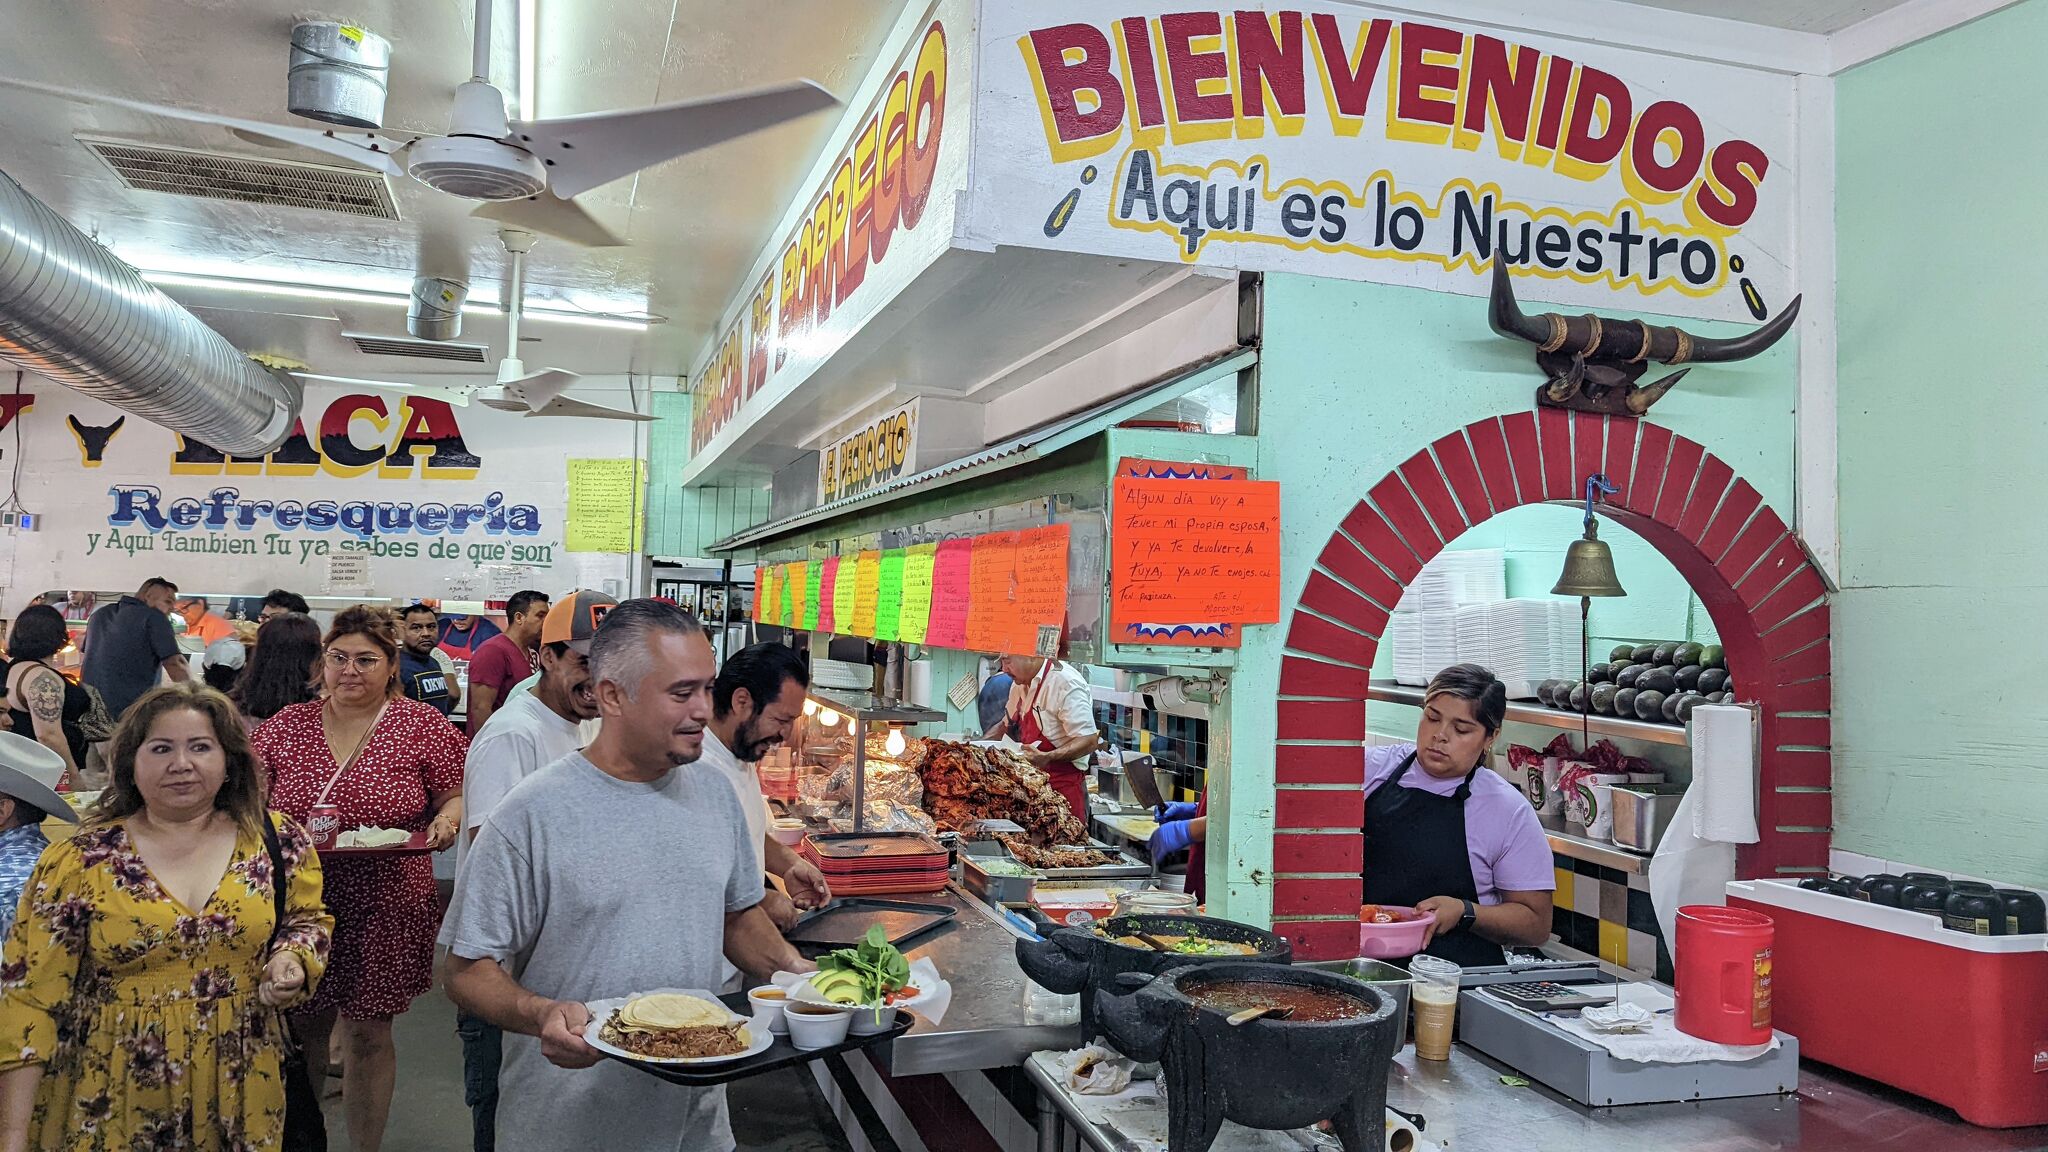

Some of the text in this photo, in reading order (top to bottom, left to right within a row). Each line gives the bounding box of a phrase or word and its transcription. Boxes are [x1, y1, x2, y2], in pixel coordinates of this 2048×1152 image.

[1020, 10, 1770, 235] BIENVENIDOS
[1282, 190, 1345, 240] es
[1375, 179, 1424, 252] lo
[170, 393, 482, 480] CA
[825, 411, 909, 502] EL PECHOCHO
[1237, 496, 1245, 508] A
[87, 532, 102, 555] y
[162, 530, 257, 555] Tambien
[264, 533, 293, 556] Tu
[300, 537, 330, 564] ya
[340, 535, 419, 558] sabes
[429, 537, 460, 559] de
[467, 543, 505, 568] que
[310, 817, 337, 832] Pepper
[320, 816, 332, 824] Dr
